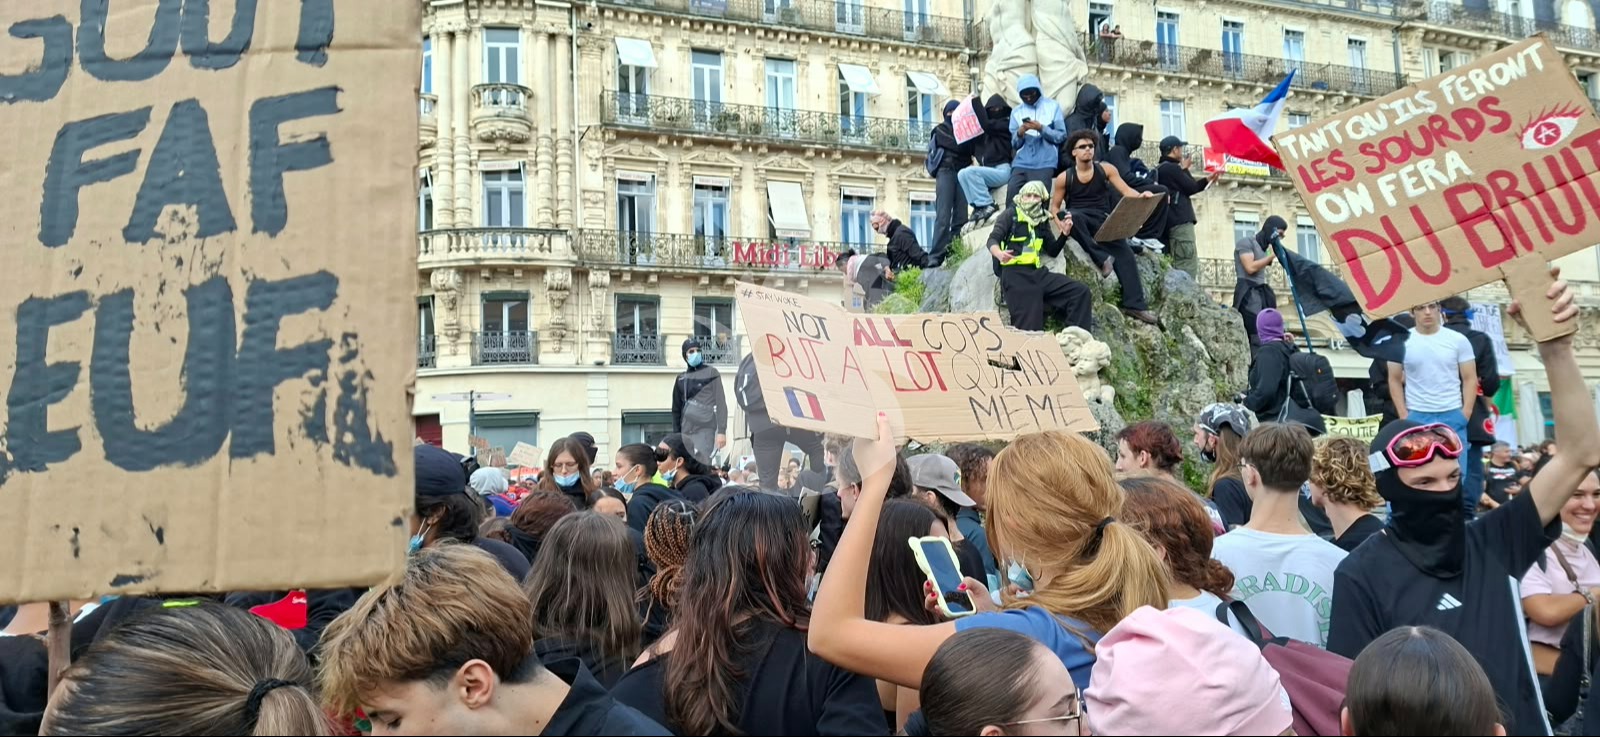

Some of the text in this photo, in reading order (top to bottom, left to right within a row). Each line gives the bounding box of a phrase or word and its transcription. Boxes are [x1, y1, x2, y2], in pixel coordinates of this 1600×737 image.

[1439, 42, 1546, 105] FERONT
[37, 85, 344, 247] FAF
[1297, 96, 1513, 194] LES SOURDS
[1315, 150, 1474, 224] ON FERA
[732, 241, 790, 266] Midi
[1331, 204, 1451, 312] DU
[766, 333, 1060, 396] BUT A LOT QUAND
[781, 309, 1003, 353] NOT ALL COPS
[0, 270, 340, 488] EUF
[969, 386, 1083, 431] MÊME
